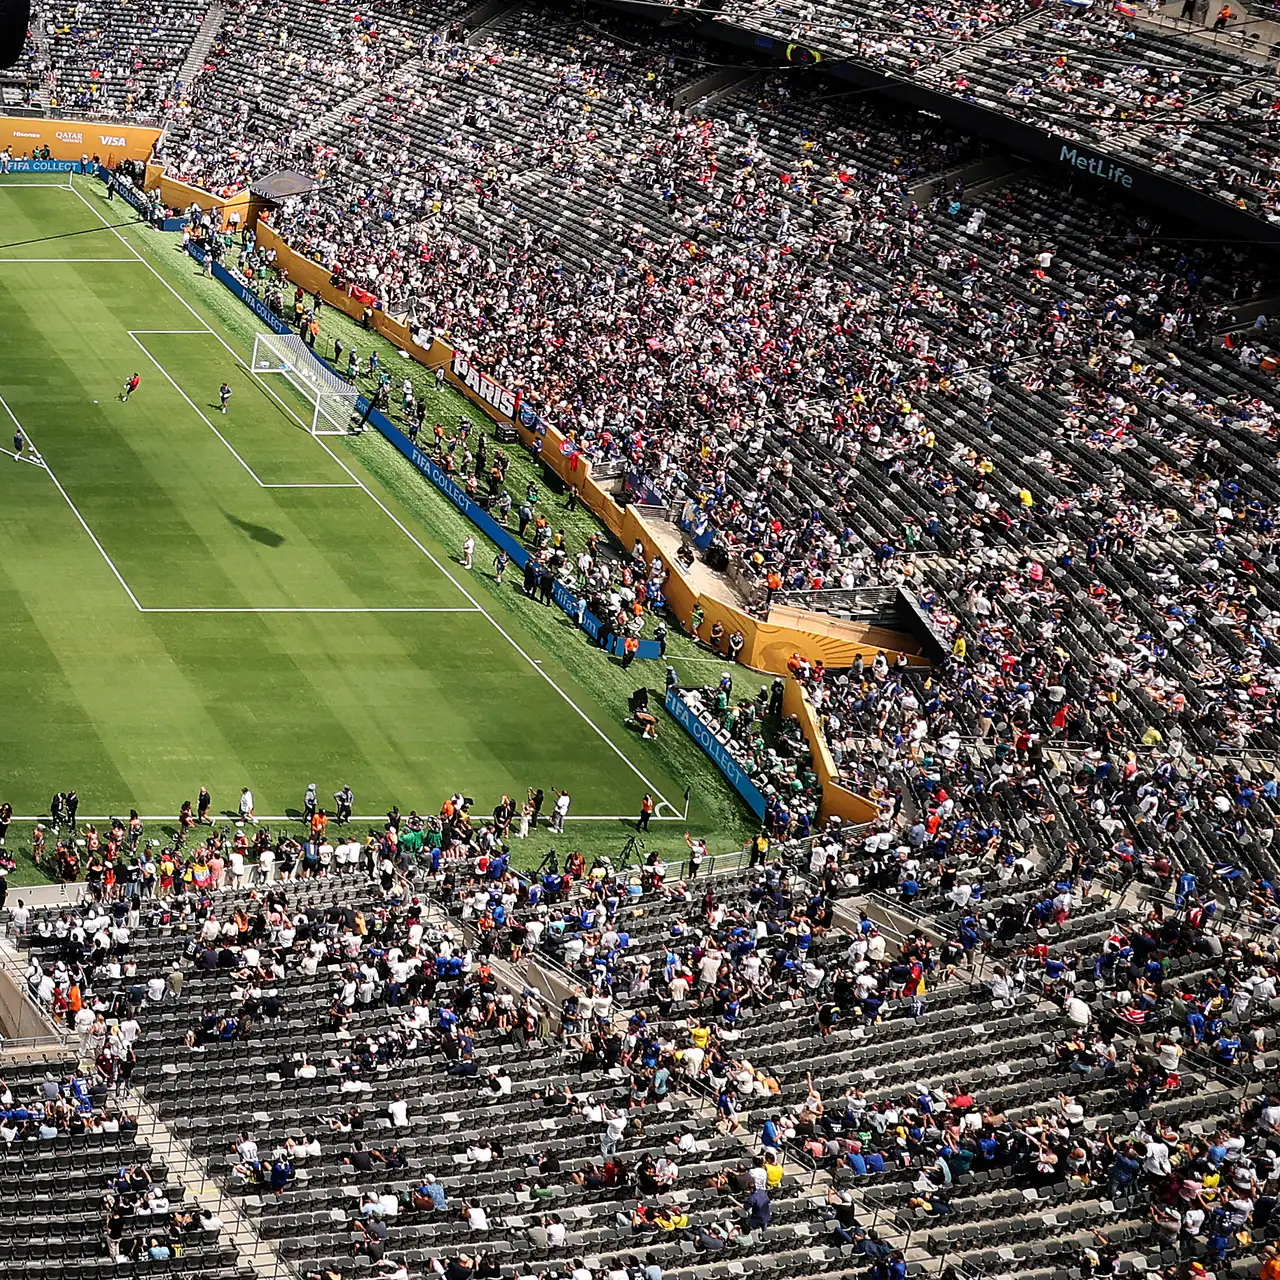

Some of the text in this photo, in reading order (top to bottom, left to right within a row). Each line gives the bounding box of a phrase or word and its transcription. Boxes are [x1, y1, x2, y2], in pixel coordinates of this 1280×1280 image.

[55, 131, 83, 140] QATAR
[99, 135, 127, 147] VISA
[7, 161, 78, 171] FIFA COLLECT
[1059, 145, 1133, 188] MetLife
[241, 288, 284, 333] FIFA COLLECT
[453, 356, 517, 418] PARIS
[412, 448, 472, 511] FIFA COLLECT
[665, 691, 743, 785] FIFA COLLECT
